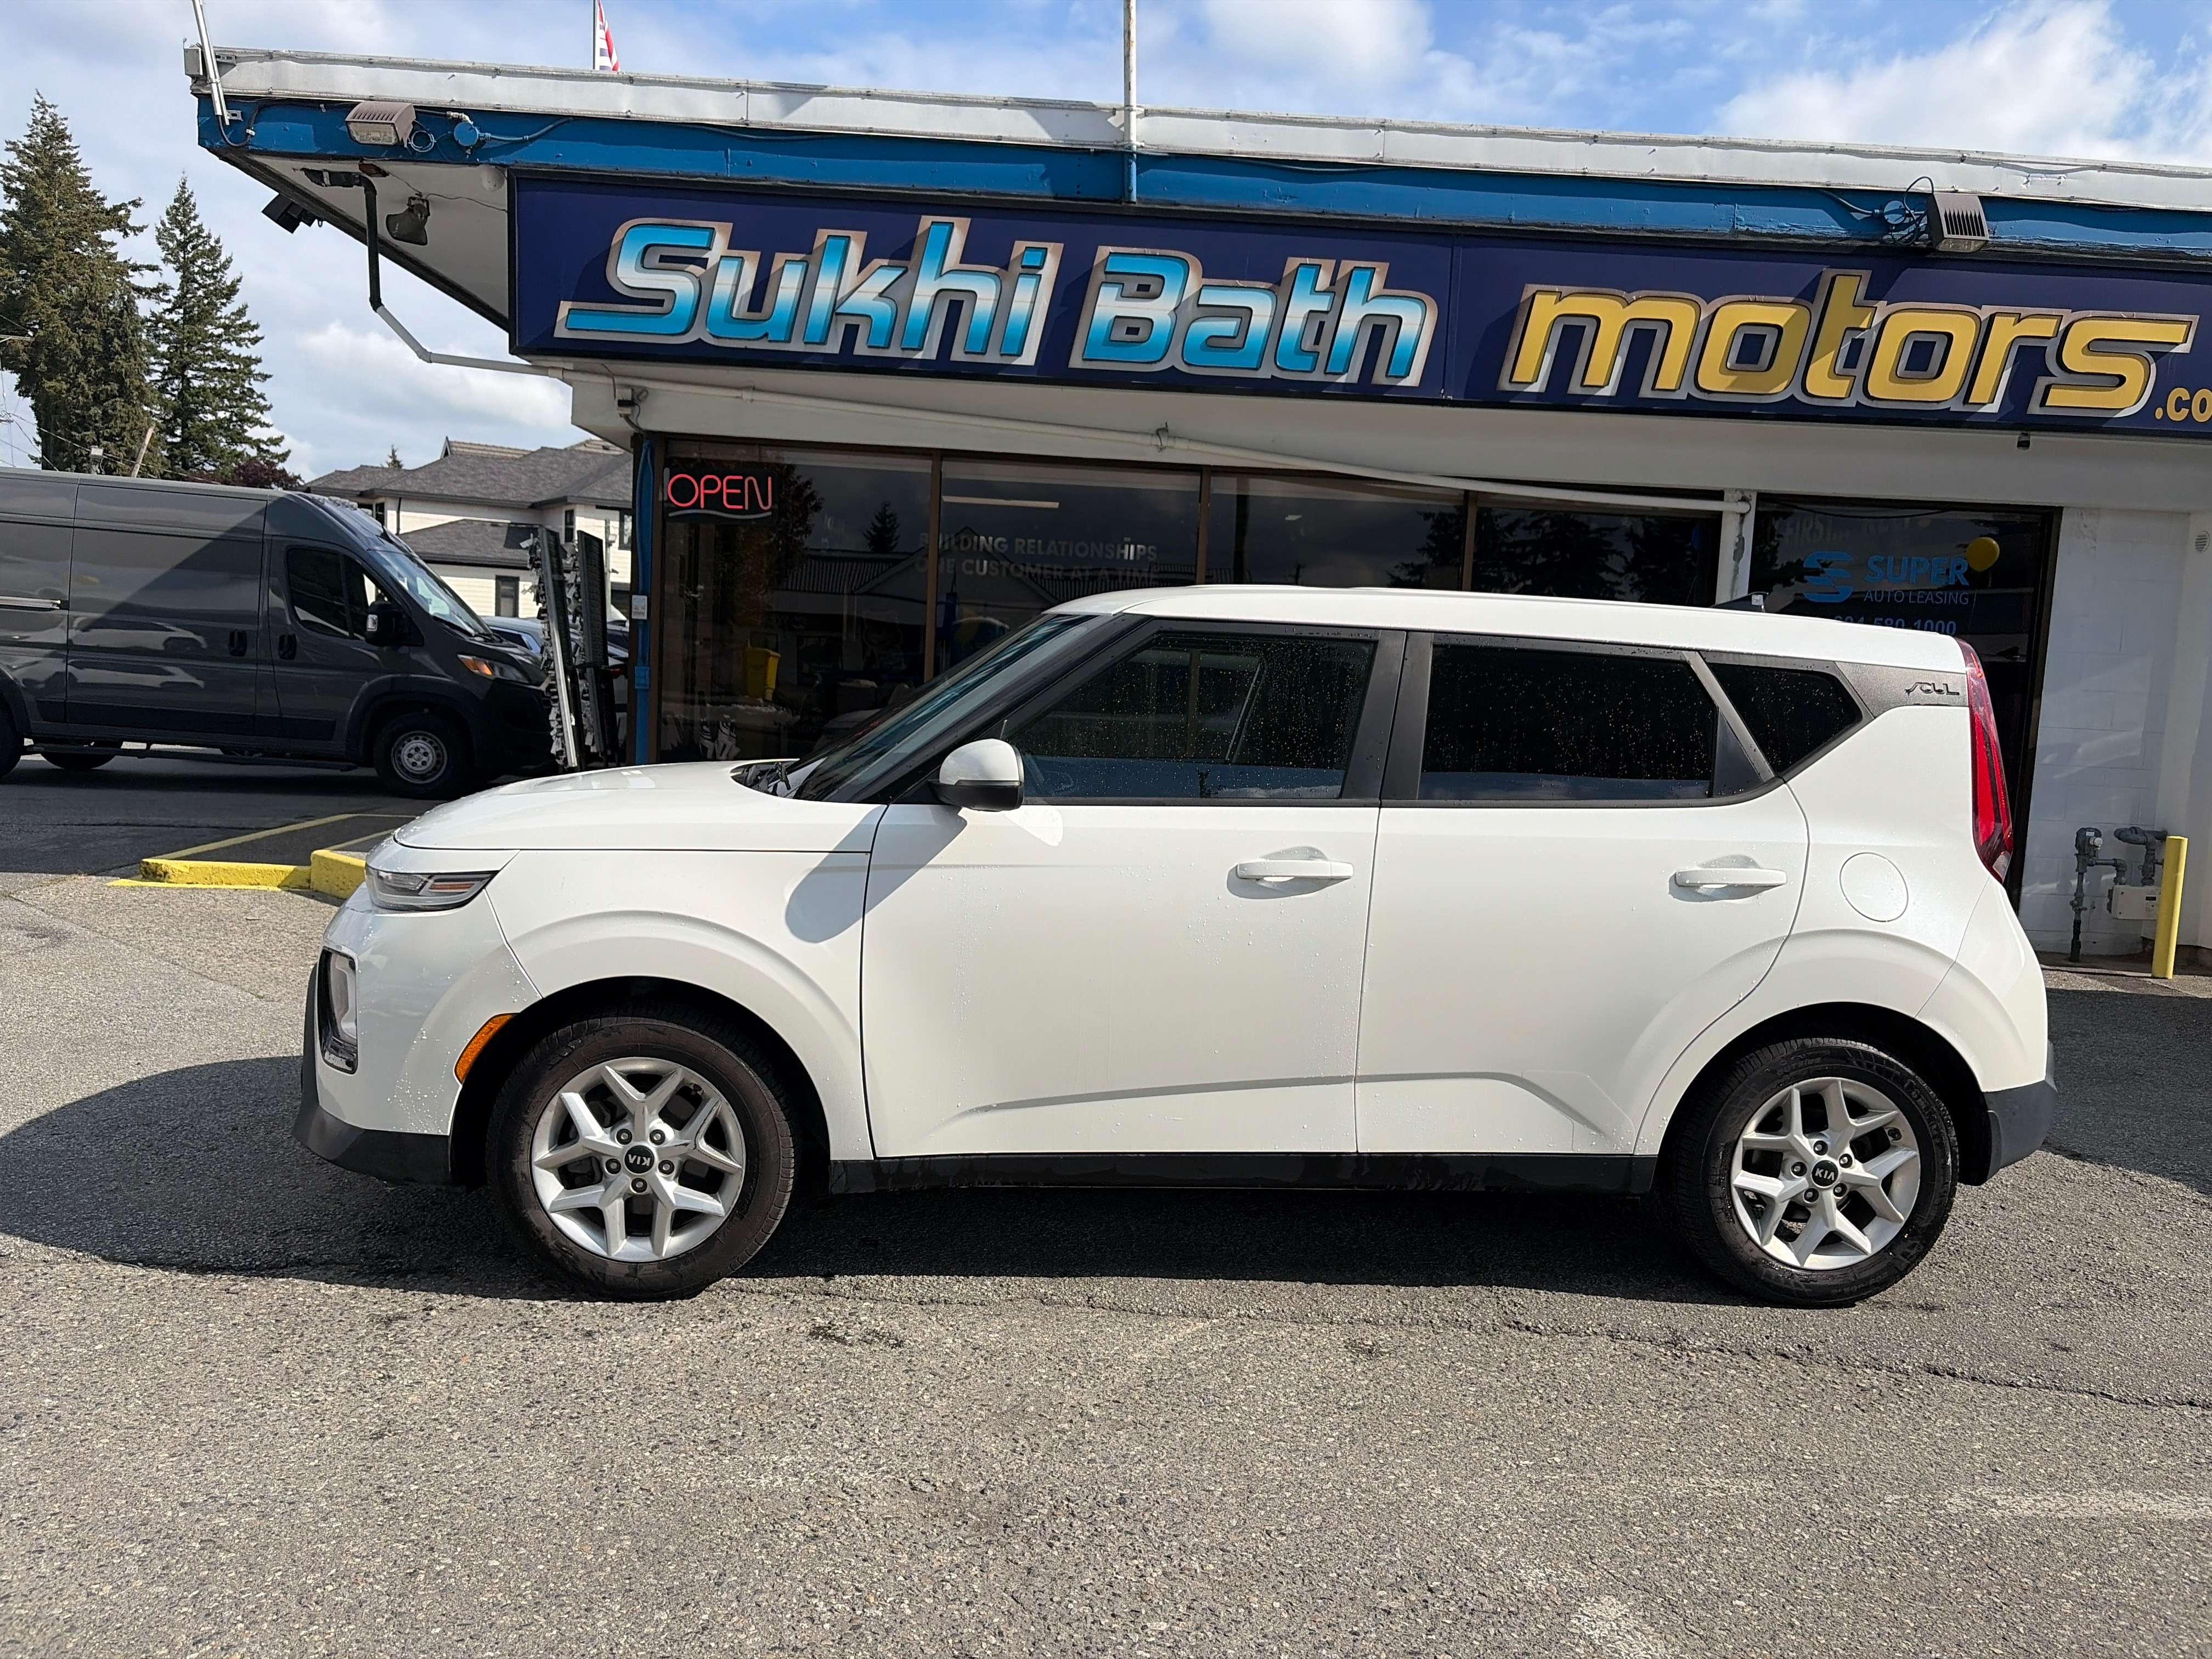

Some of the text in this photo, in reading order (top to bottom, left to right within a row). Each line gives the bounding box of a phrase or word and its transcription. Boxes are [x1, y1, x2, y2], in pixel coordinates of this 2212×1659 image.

[555, 215, 1063, 366] Sukhi
[1068, 245, 1438, 387] Bath
[667, 473, 772, 510] OPEN
[1015, 537, 1157, 561] RELATIONSHIPS
[962, 558, 1063, 579] CUSTOMER
[1865, 554, 1969, 586] SUPER
[1863, 590, 1970, 605] AUTO LEASING
[628, 1154, 651, 1166] KIA
[1815, 1167, 1835, 1181] KIA
